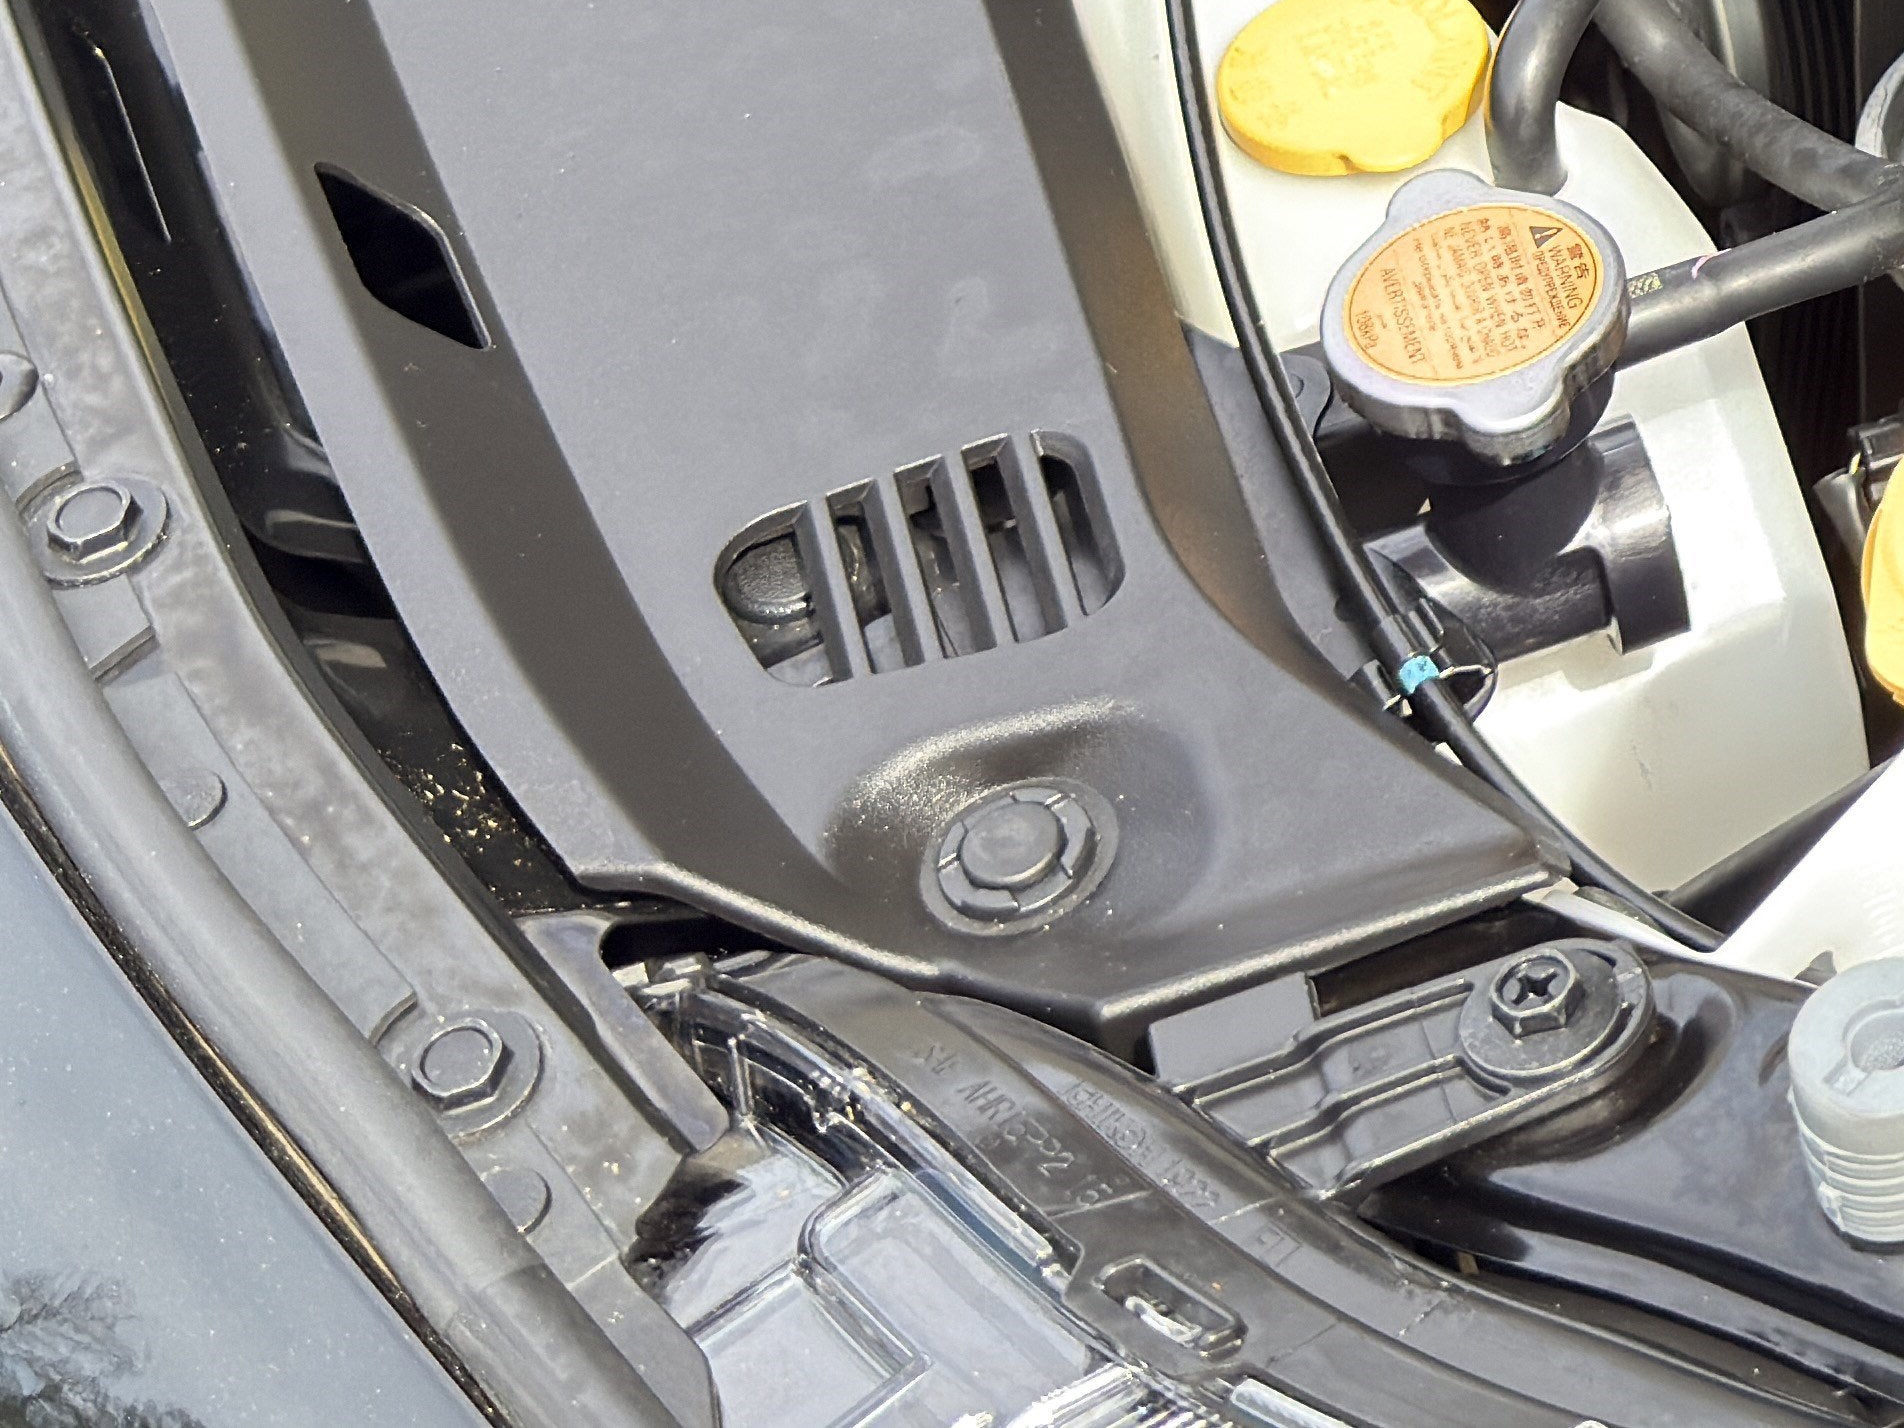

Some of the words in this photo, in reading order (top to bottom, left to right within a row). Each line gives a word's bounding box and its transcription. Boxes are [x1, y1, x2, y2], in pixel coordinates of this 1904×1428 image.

[1546, 243, 1584, 310] WARNING
[1378, 264, 1427, 366] AVERTISSEMENT
[1498, 329, 1518, 354] HOT
